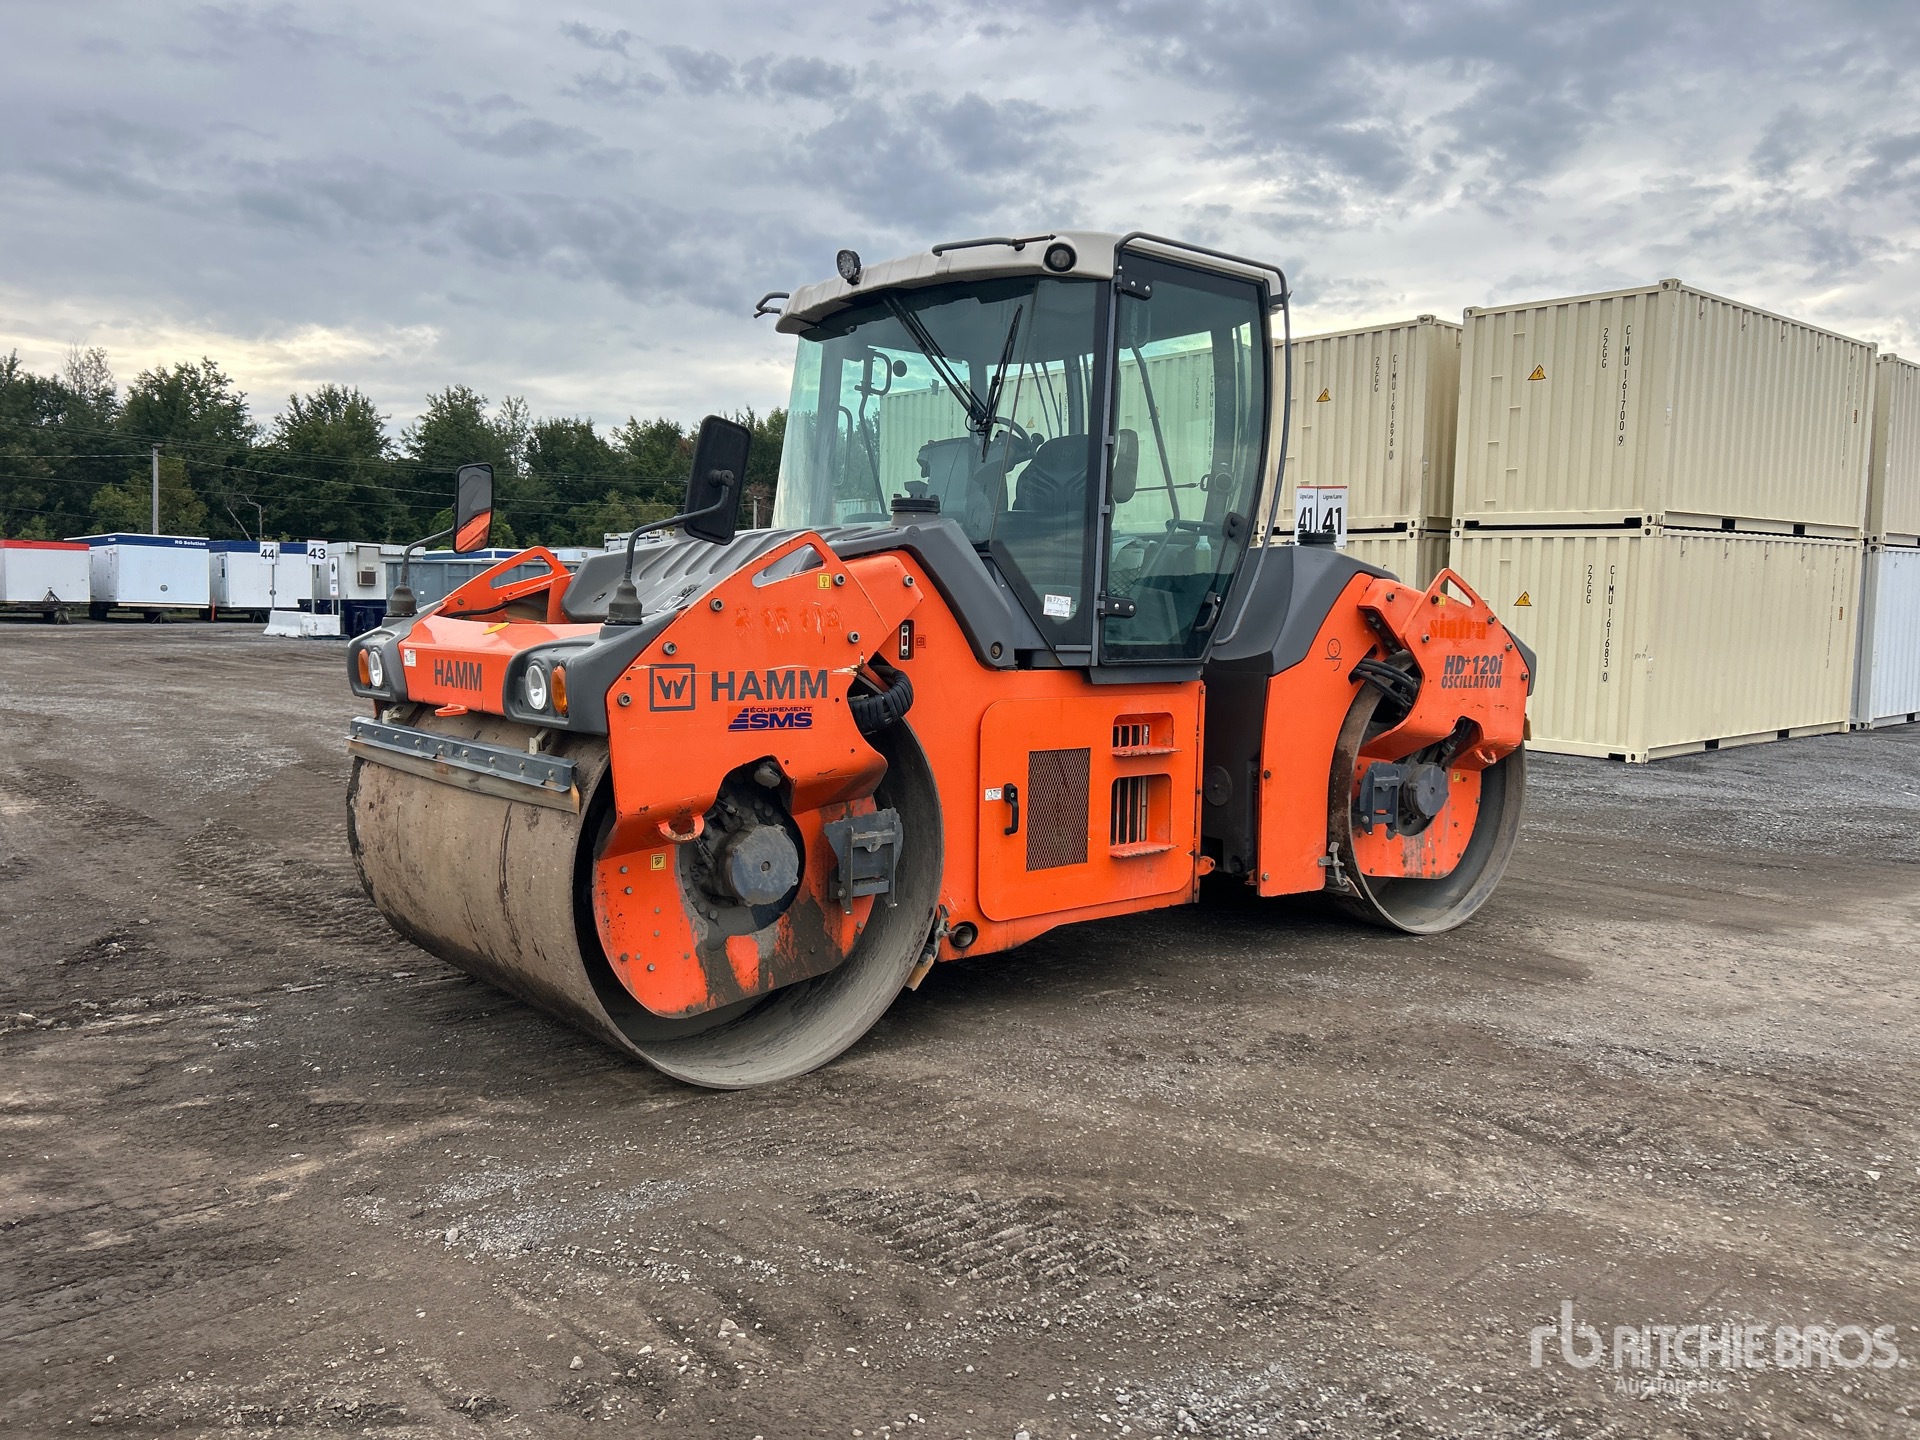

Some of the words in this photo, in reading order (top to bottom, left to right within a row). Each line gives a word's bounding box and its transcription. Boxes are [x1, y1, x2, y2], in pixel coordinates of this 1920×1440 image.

[1601, 327, 1609, 368] 22GG
[1619, 369, 1627, 431] 161700
[1322, 493, 1343, 501] Ligne/Lane
[1297, 506, 1313, 533] 41
[1321, 506, 1342, 535] 41
[260, 548, 275, 560] 44
[308, 547, 326, 560] 43
[1585, 564, 1593, 604] 22GG
[1607, 565, 1615, 605] CIMU
[1603, 608, 1611, 668] 161683
[434, 658, 483, 692] HAMM
[711, 669, 828, 702] HAMM
[1441, 676, 1503, 689] OSCILLATION
[749, 712, 813, 729] SMS
